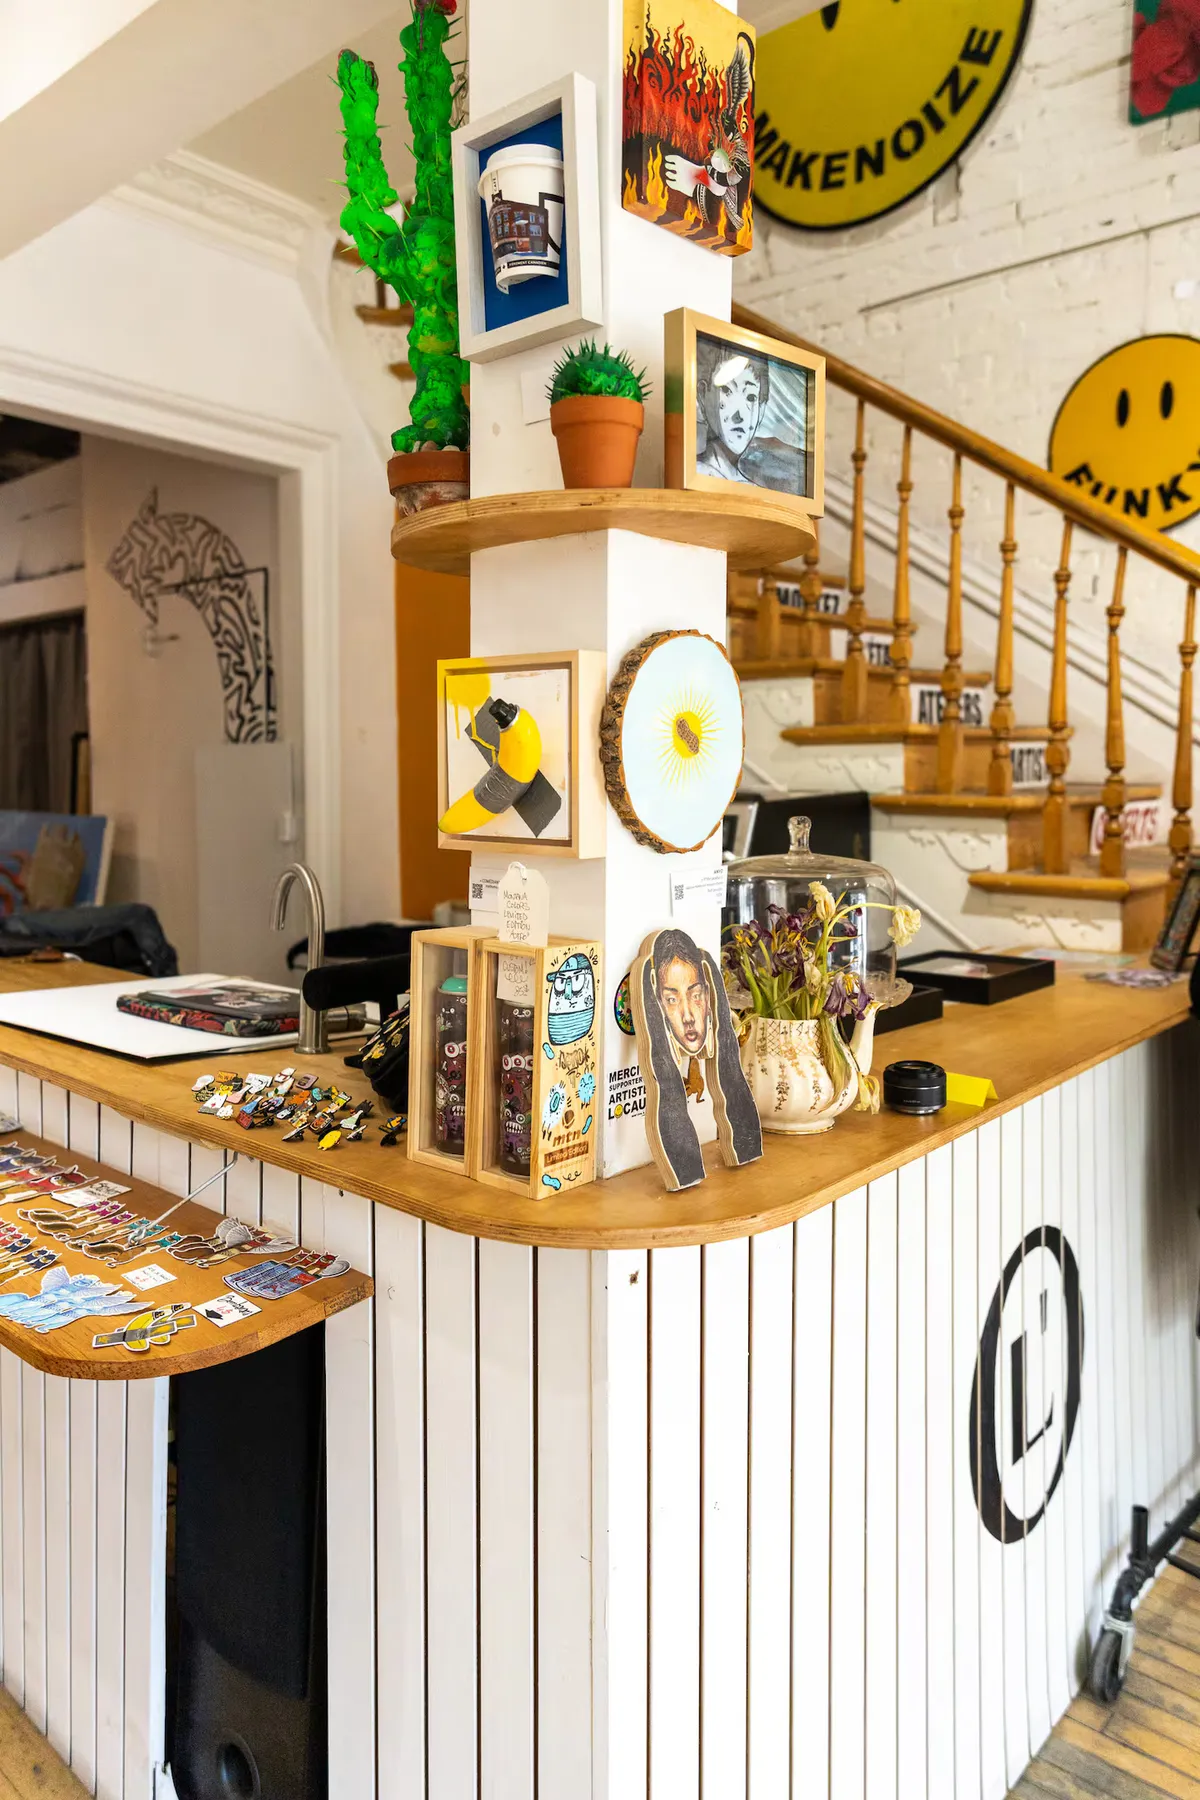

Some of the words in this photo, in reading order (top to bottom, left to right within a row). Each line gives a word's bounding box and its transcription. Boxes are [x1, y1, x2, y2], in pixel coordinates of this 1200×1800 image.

[608, 1065, 640, 1084] MERCI
[608, 1076, 643, 1092] SUPPORTER
[607, 1097, 646, 1120] LOCAU
[552, 1129, 581, 1147] mtn
[546, 1150, 568, 1164] Limited
[567, 1144, 588, 1157] Edition
